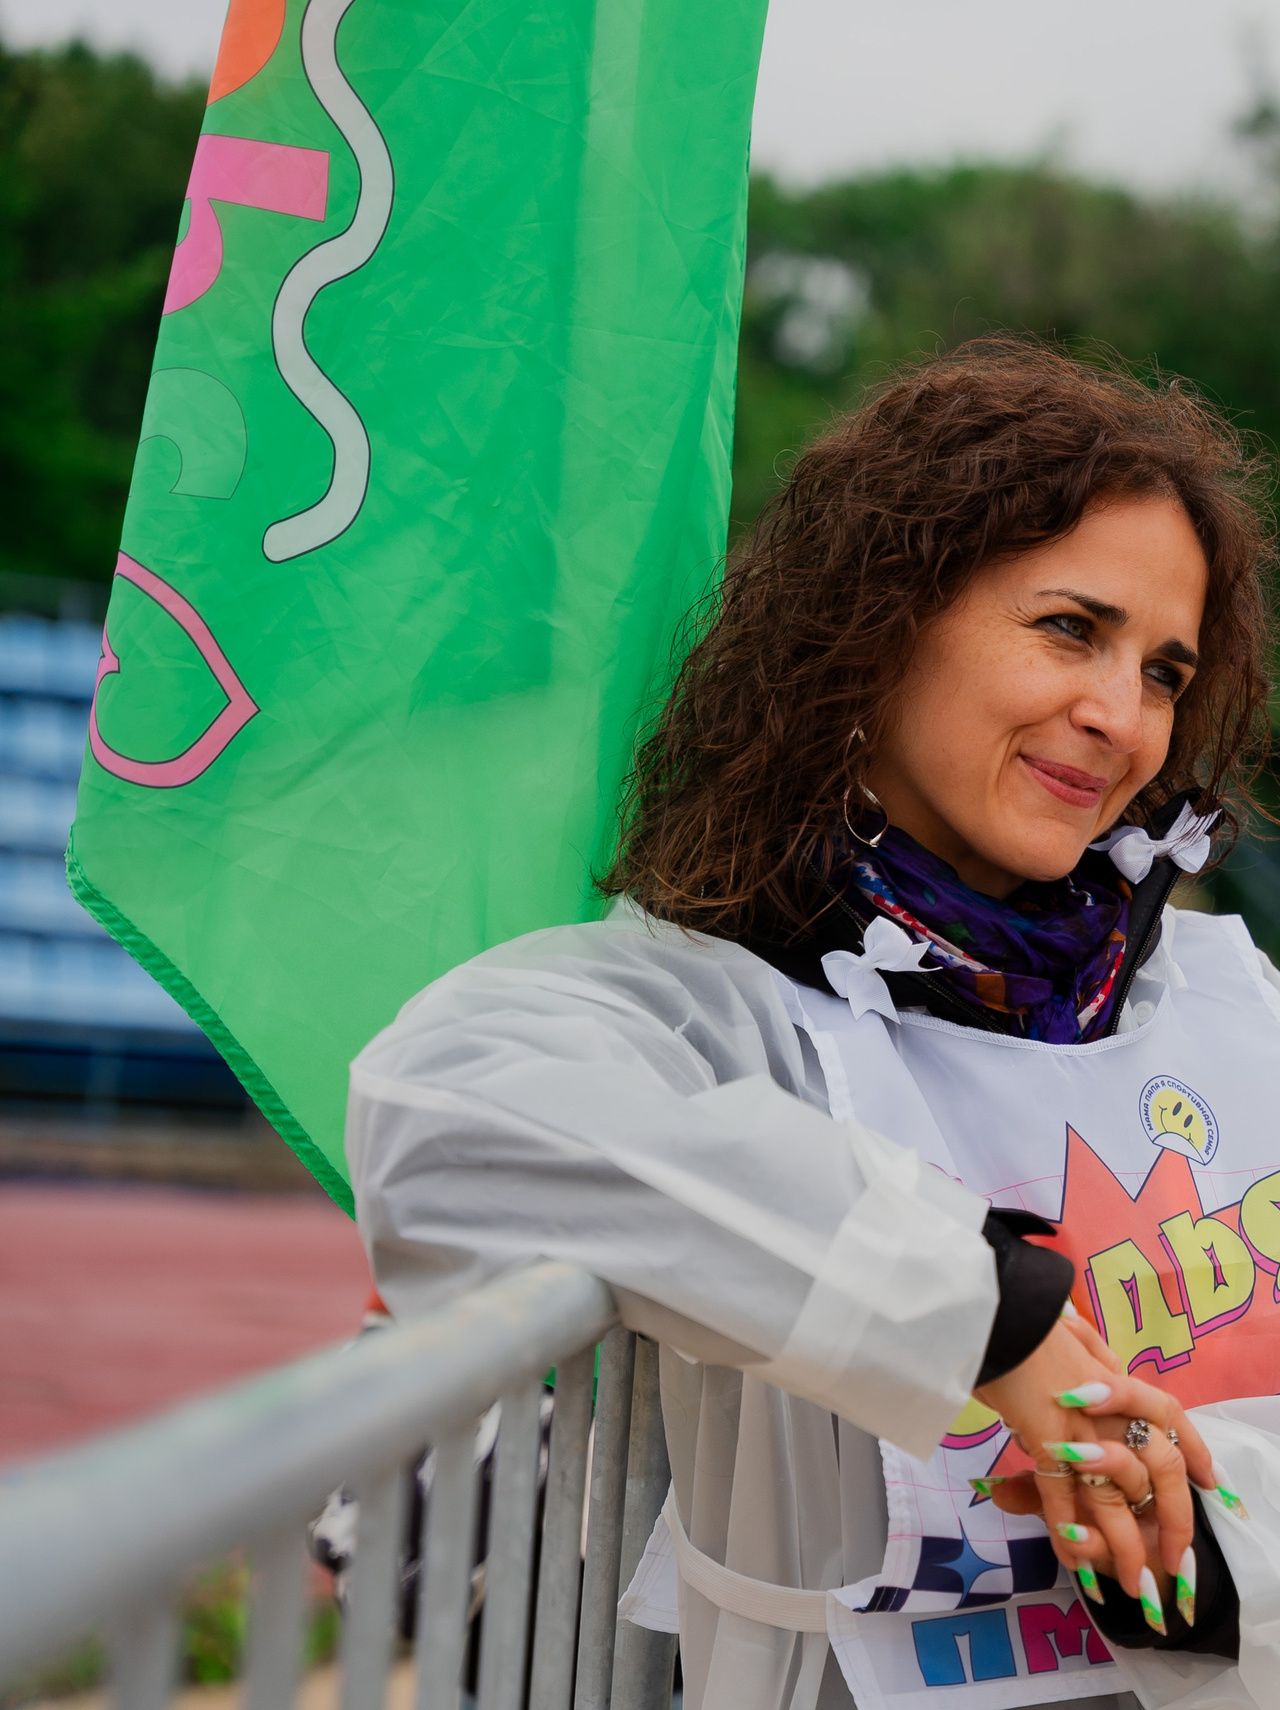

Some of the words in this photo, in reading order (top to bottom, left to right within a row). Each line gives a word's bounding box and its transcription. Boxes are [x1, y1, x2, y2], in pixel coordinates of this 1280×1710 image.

[1145, 1082, 1161, 1102] ПАПА
[1166, 1080, 1213, 1127] СПОРТИВНАЯ
[1143, 1102, 1154, 1131] МАМА
